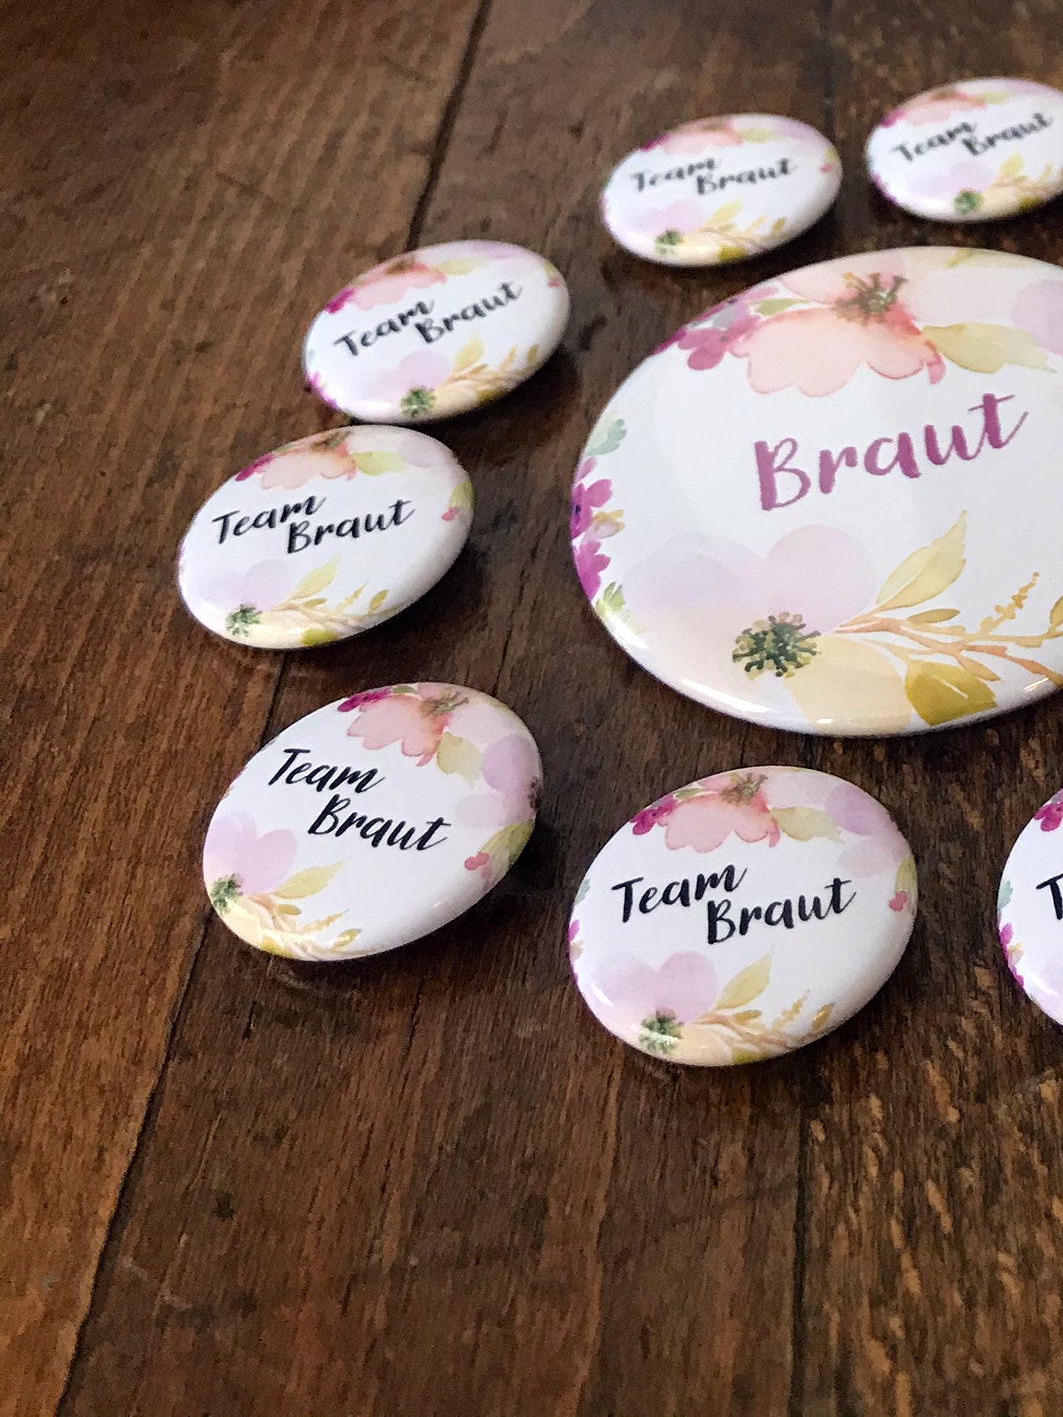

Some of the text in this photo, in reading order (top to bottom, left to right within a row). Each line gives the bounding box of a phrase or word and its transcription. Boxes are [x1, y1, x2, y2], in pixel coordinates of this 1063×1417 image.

[892, 121, 977, 163] Team
[963, 112, 1052, 157] Braut
[629, 156, 717, 192] Team
[696, 156, 797, 197] Braut
[332, 296, 435, 359] Team
[415, 281, 523, 342] Braut
[753, 393, 1029, 511] Braut
[212, 494, 327, 545] Team
[286, 499, 415, 554] Braut
[268, 748, 384, 795] Team
[307, 794, 451, 851] Braut
[612, 864, 748, 922] Team
[706, 876, 859, 945] Braut
